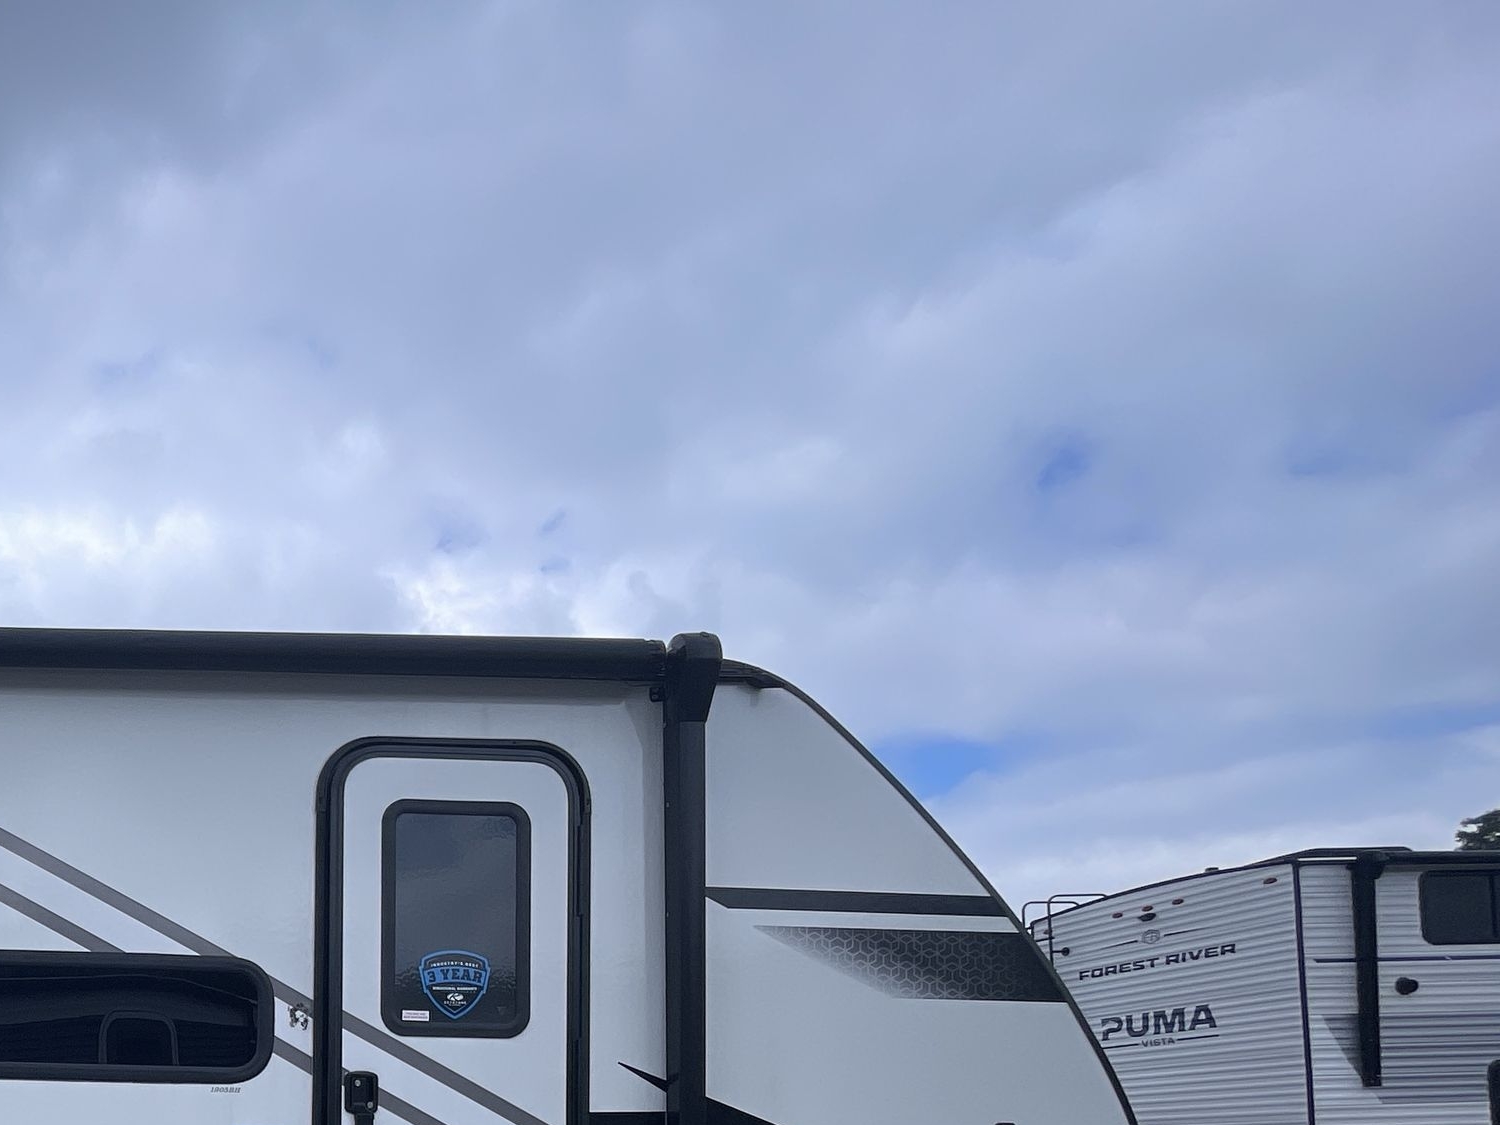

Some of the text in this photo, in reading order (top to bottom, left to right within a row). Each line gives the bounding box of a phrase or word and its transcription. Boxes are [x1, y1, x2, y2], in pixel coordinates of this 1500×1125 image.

[1078, 943, 1237, 981] FOREST RIVER
[427, 968, 483, 983] 3 YEAR
[1101, 1004, 1218, 1042] PUMA
[1141, 1037, 1176, 1048] VISTA
